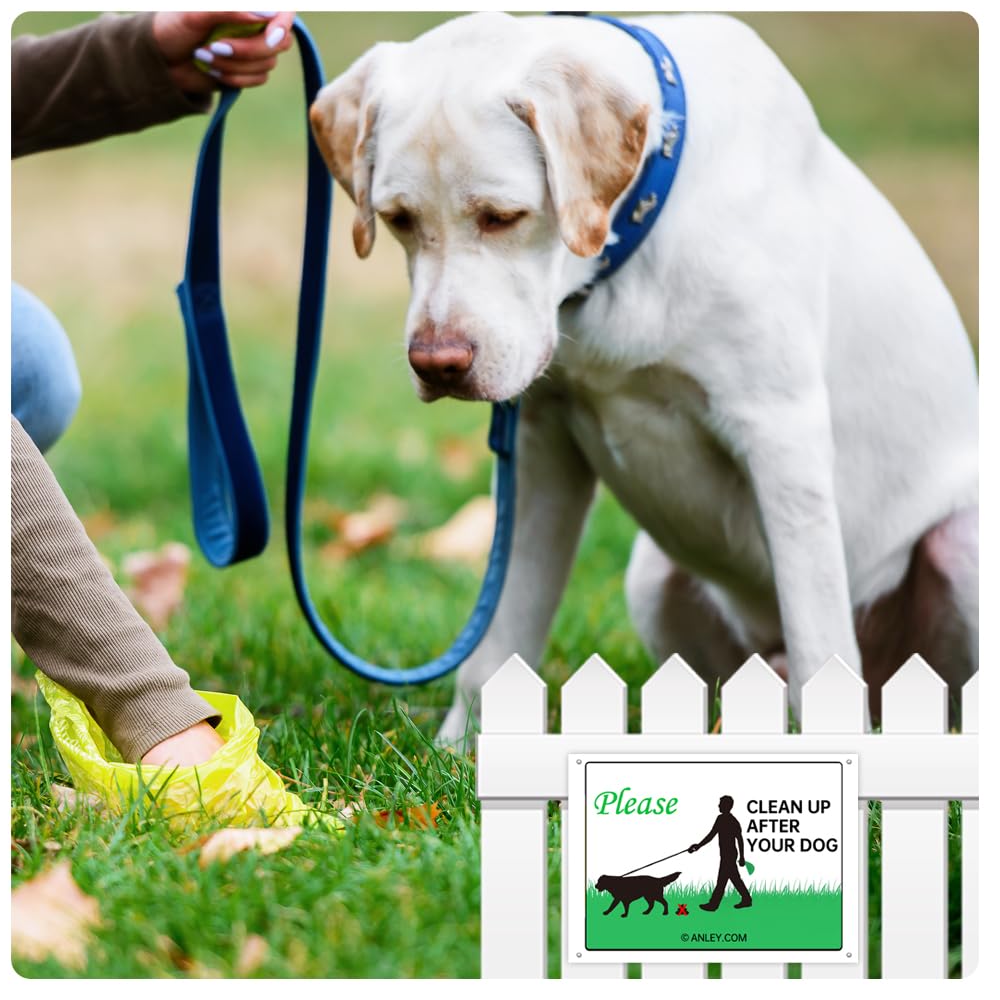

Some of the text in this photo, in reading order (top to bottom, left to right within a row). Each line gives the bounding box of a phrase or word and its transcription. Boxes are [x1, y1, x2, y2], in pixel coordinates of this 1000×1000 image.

[594, 787, 678, 815] Please
[747, 800, 830, 814] CLEAN UP
[747, 819, 800, 833] AFTER
[747, 838, 838, 852] YOUR DOG
[691, 933, 747, 942] ANLEY.COM
